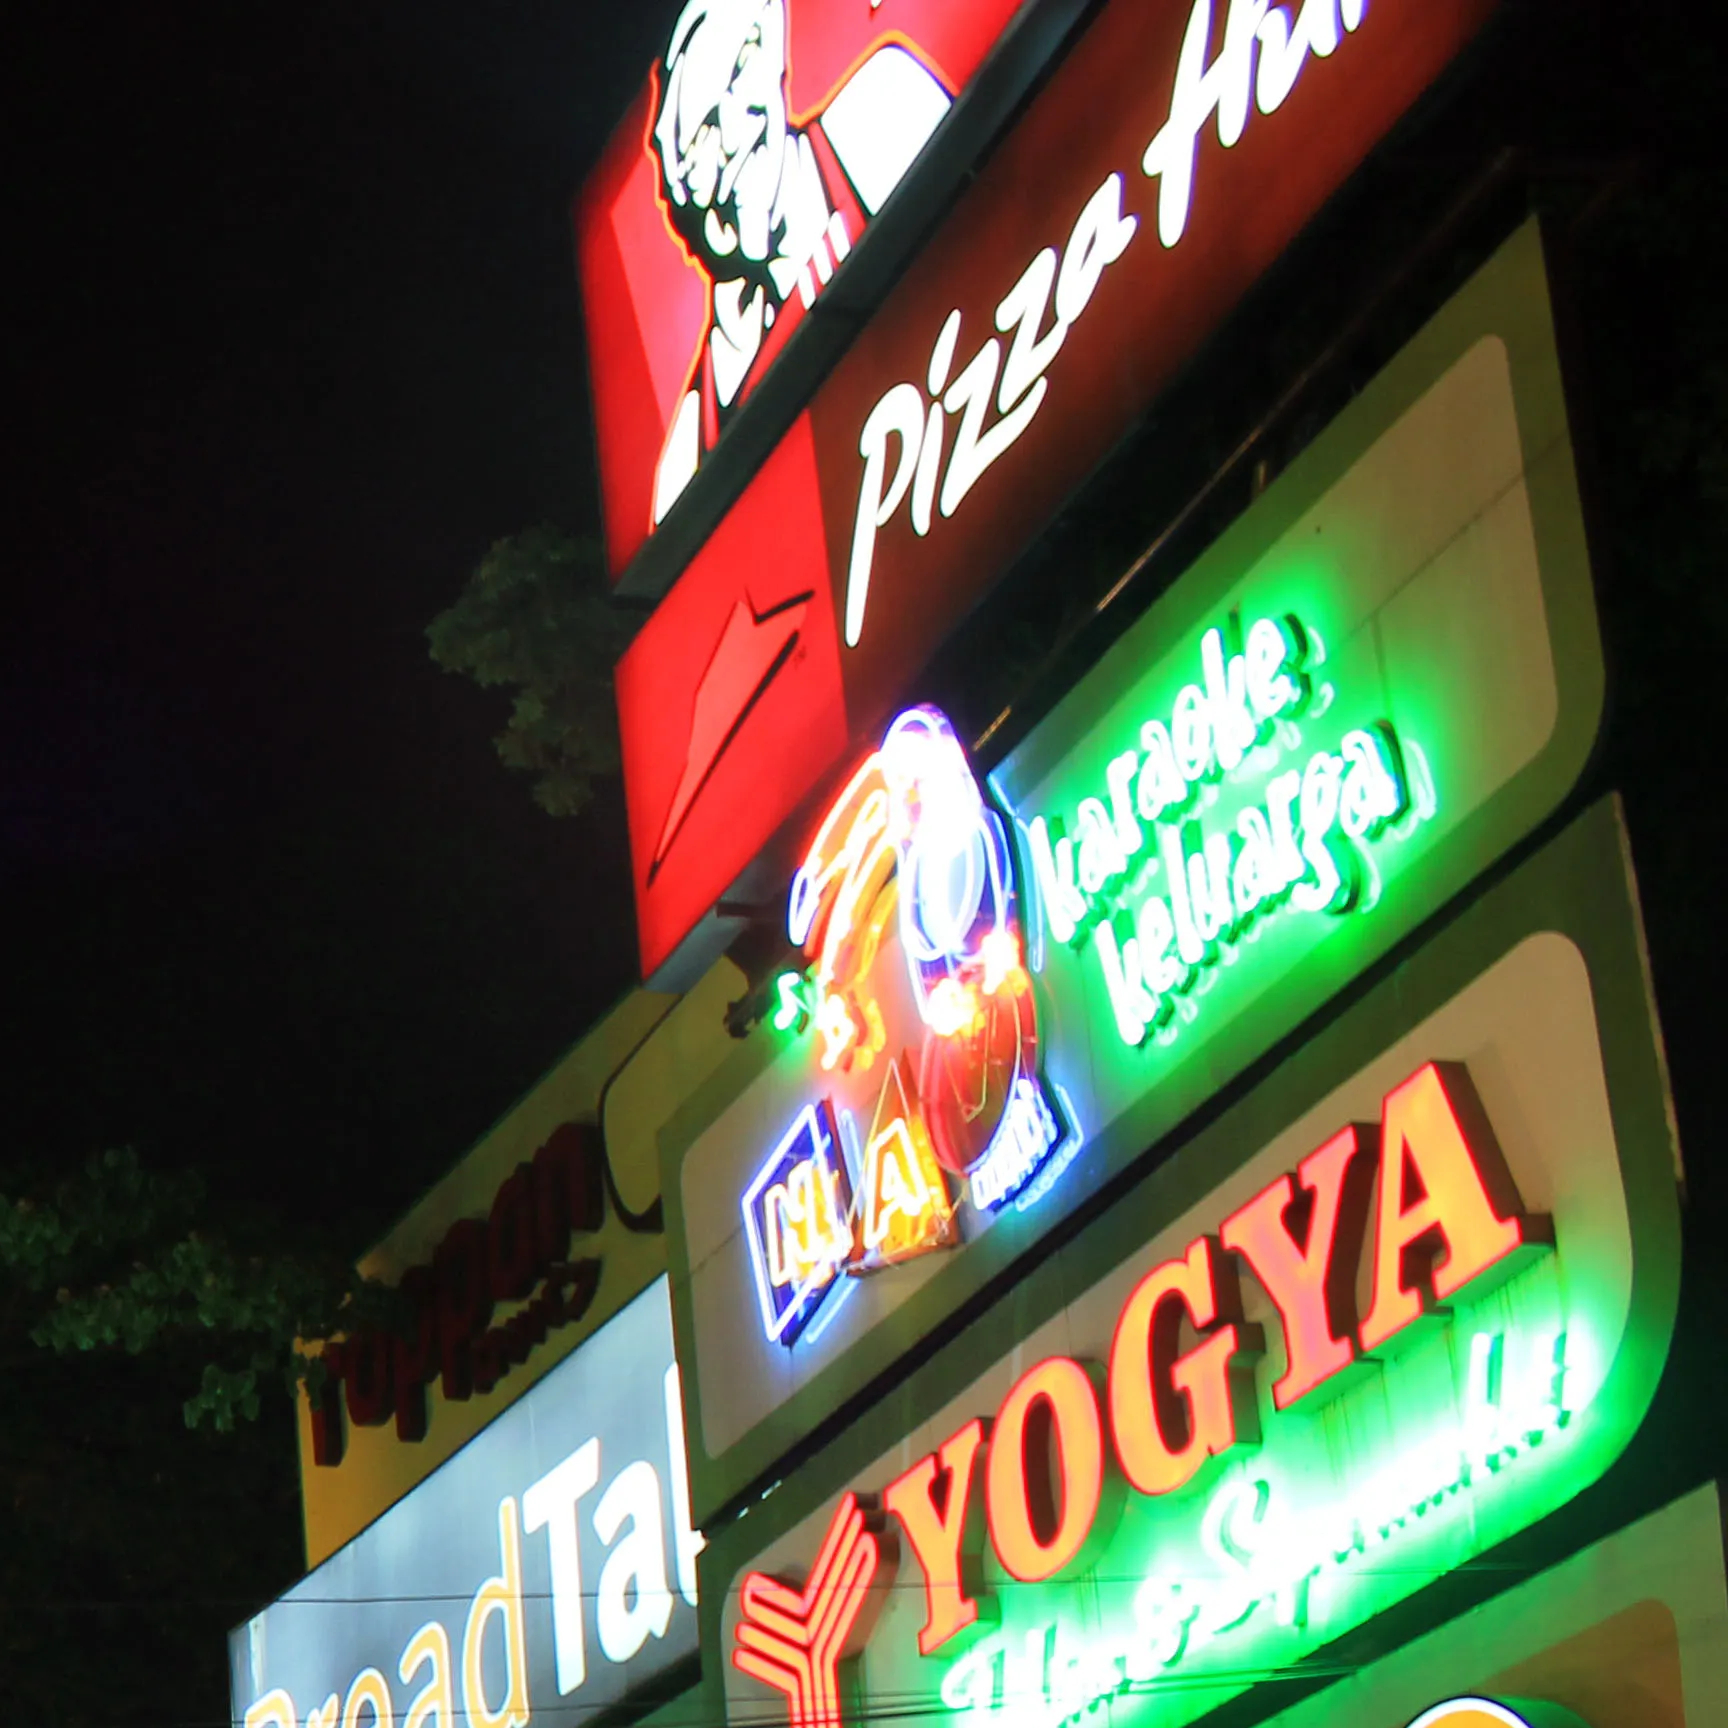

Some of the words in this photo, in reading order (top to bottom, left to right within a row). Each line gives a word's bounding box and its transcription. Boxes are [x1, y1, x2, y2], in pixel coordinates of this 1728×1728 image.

[845, 172, 1136, 647] Pizza
[1142, 0, 1367, 248] Hu
[885, 1059, 1523, 1655] YOGYA
